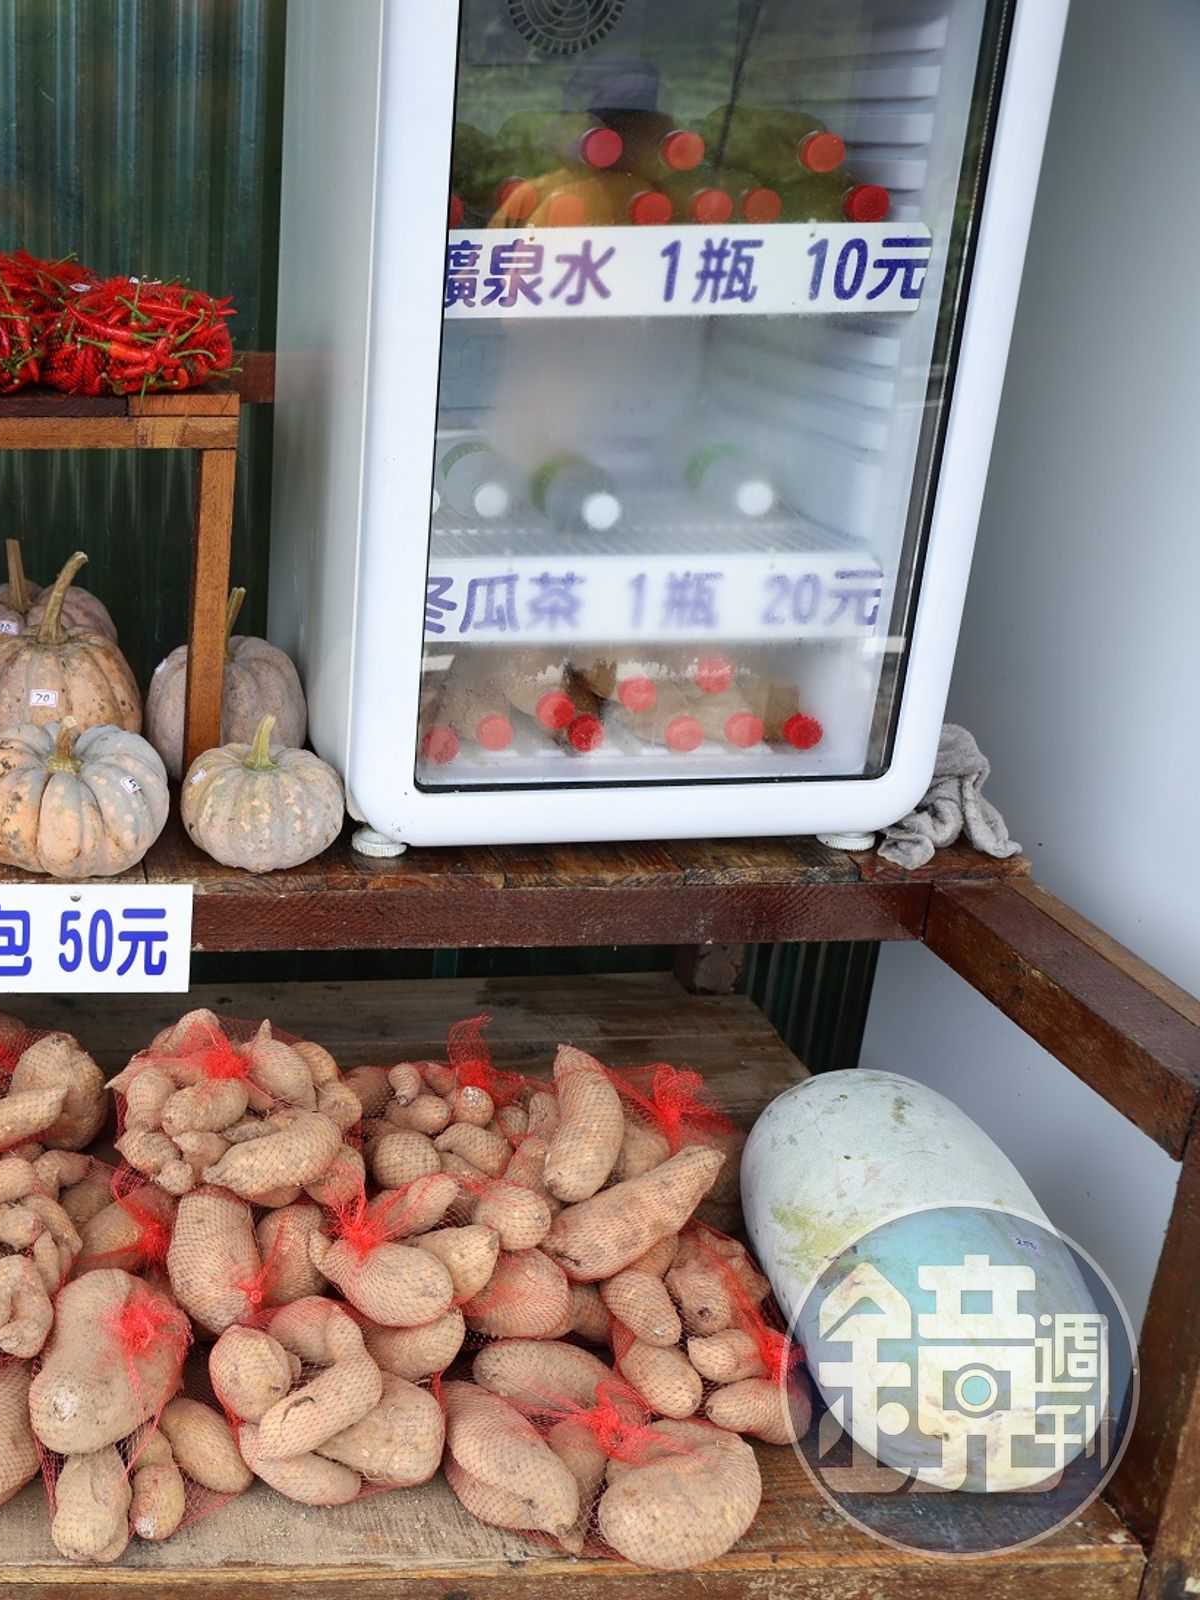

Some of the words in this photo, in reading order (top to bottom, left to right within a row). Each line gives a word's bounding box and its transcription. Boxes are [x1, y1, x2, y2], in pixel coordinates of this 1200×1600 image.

[660, 237, 763, 303] 1瓶
[807, 236, 932, 301] 10元
[626, 570, 725, 632] 1瓶
[762, 568, 885, 627] 20元
[35, 693, 50, 702] 70
[58, 908, 169, 976] 50元
